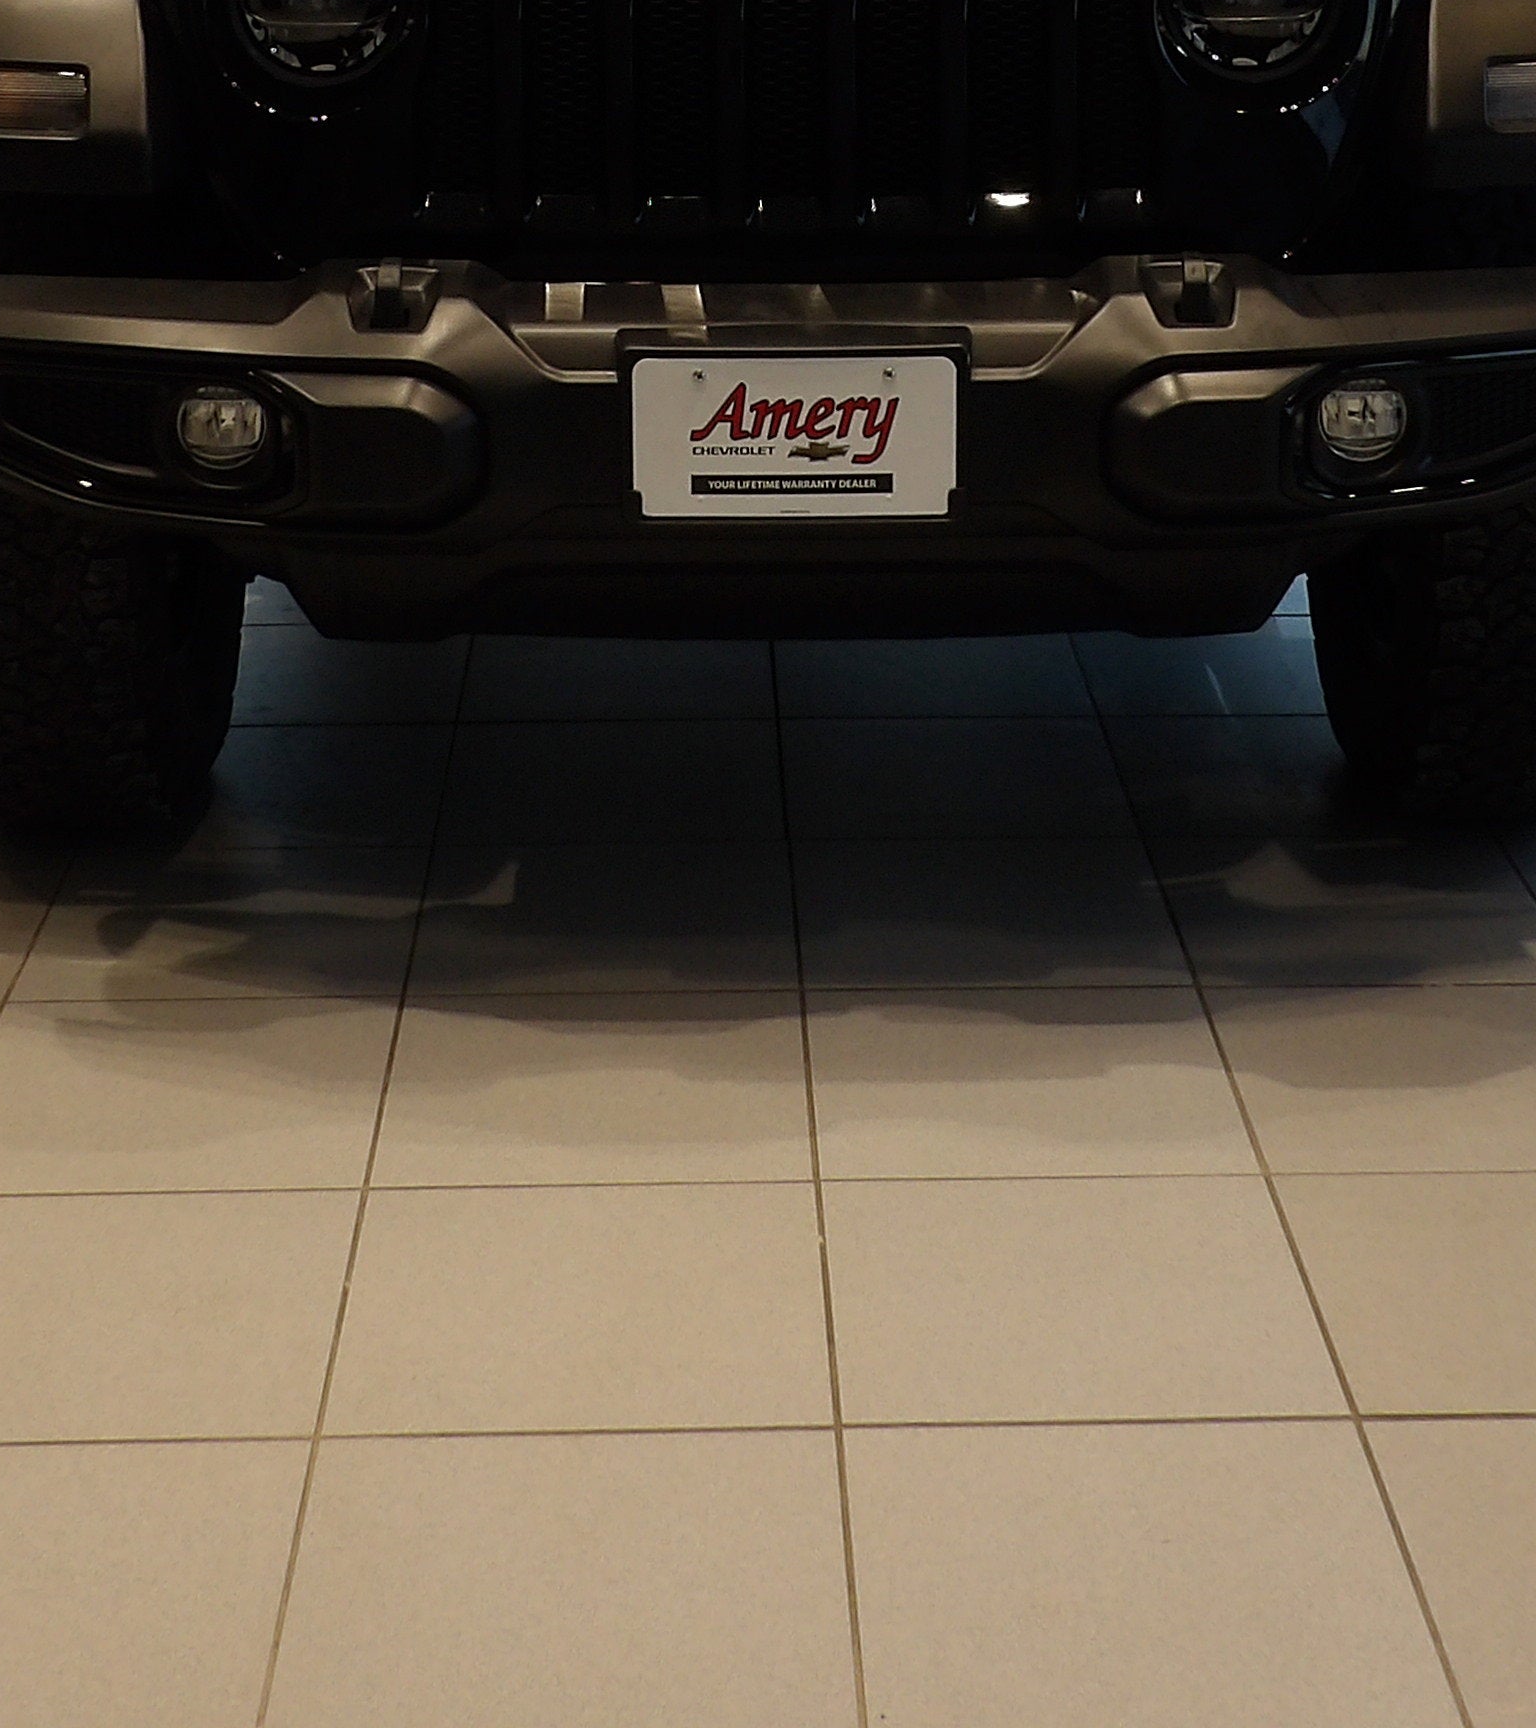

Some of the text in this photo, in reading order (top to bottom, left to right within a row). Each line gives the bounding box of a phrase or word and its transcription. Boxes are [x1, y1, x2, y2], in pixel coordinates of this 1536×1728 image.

[690, 382, 900, 464] Amery
[692, 445, 776, 456] CHEVROLET
[708, 478, 877, 490] YOUR LIFETIME WARRANTY DEALER
